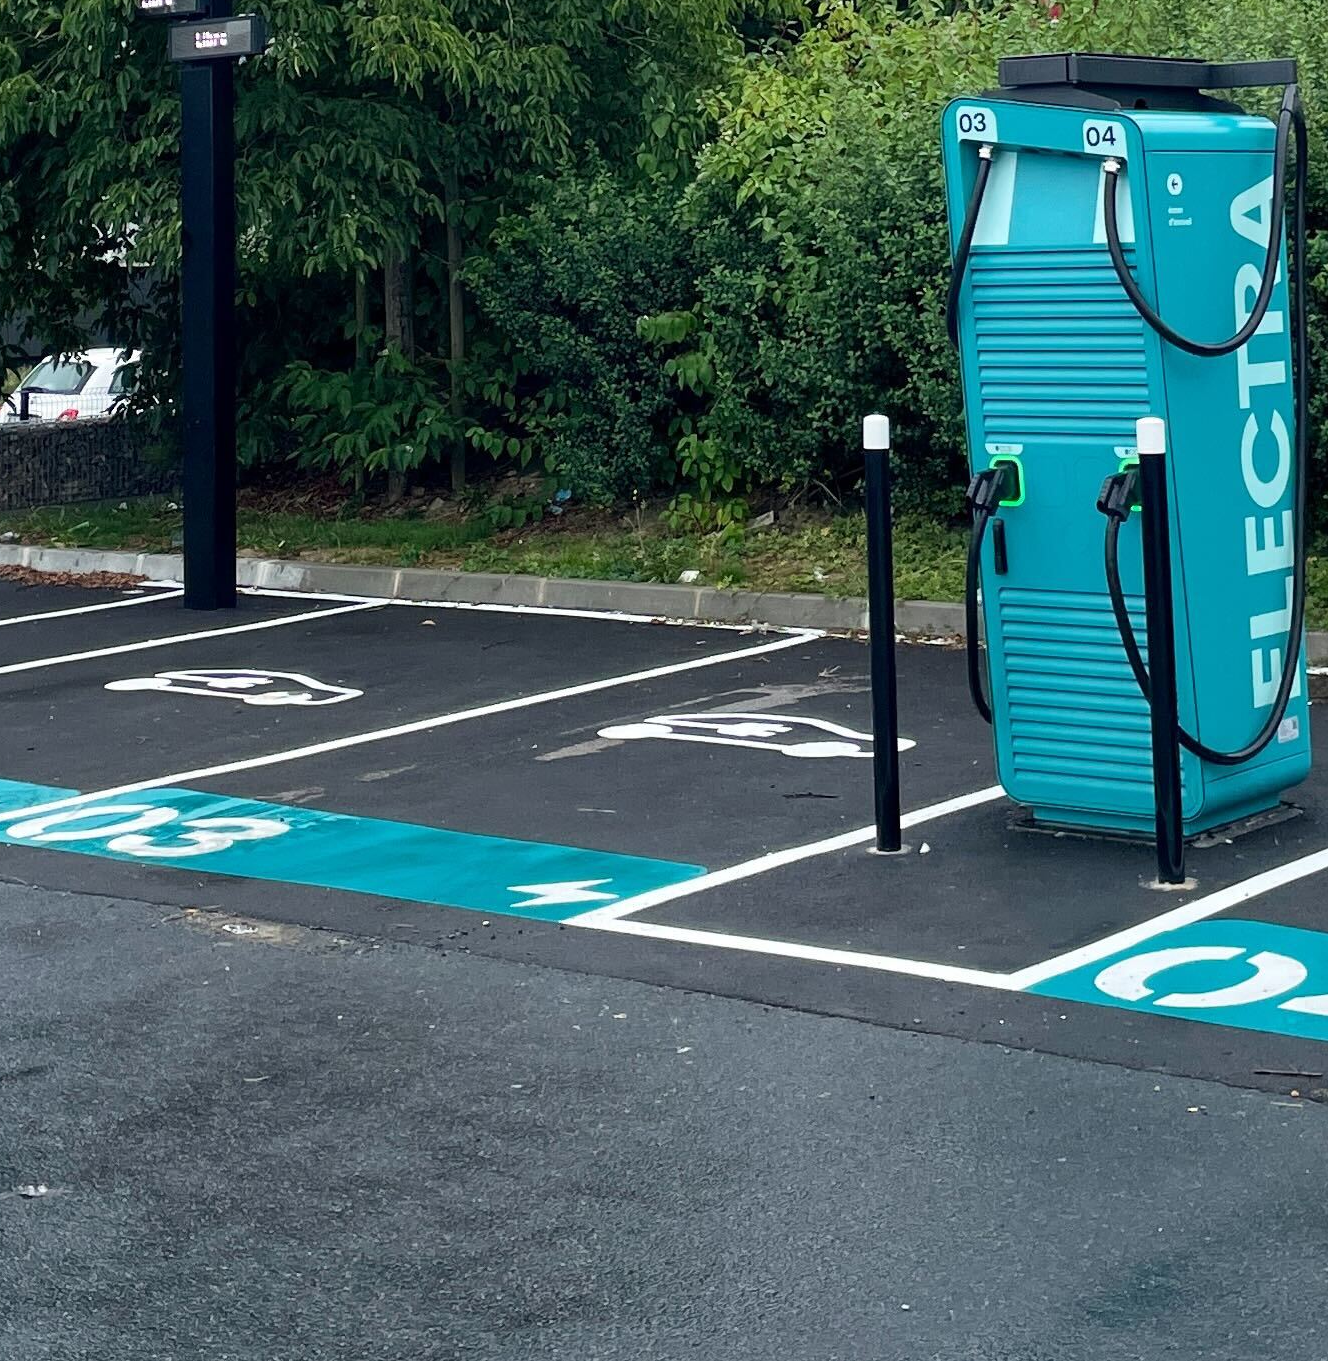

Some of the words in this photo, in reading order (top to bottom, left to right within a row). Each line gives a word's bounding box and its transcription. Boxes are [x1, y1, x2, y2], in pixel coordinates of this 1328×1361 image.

[959, 112, 987, 133] 03
[1086, 125, 1117, 147] 04
[1230, 174, 1301, 710] ELECTRA
[6, 804, 291, 857] 03
